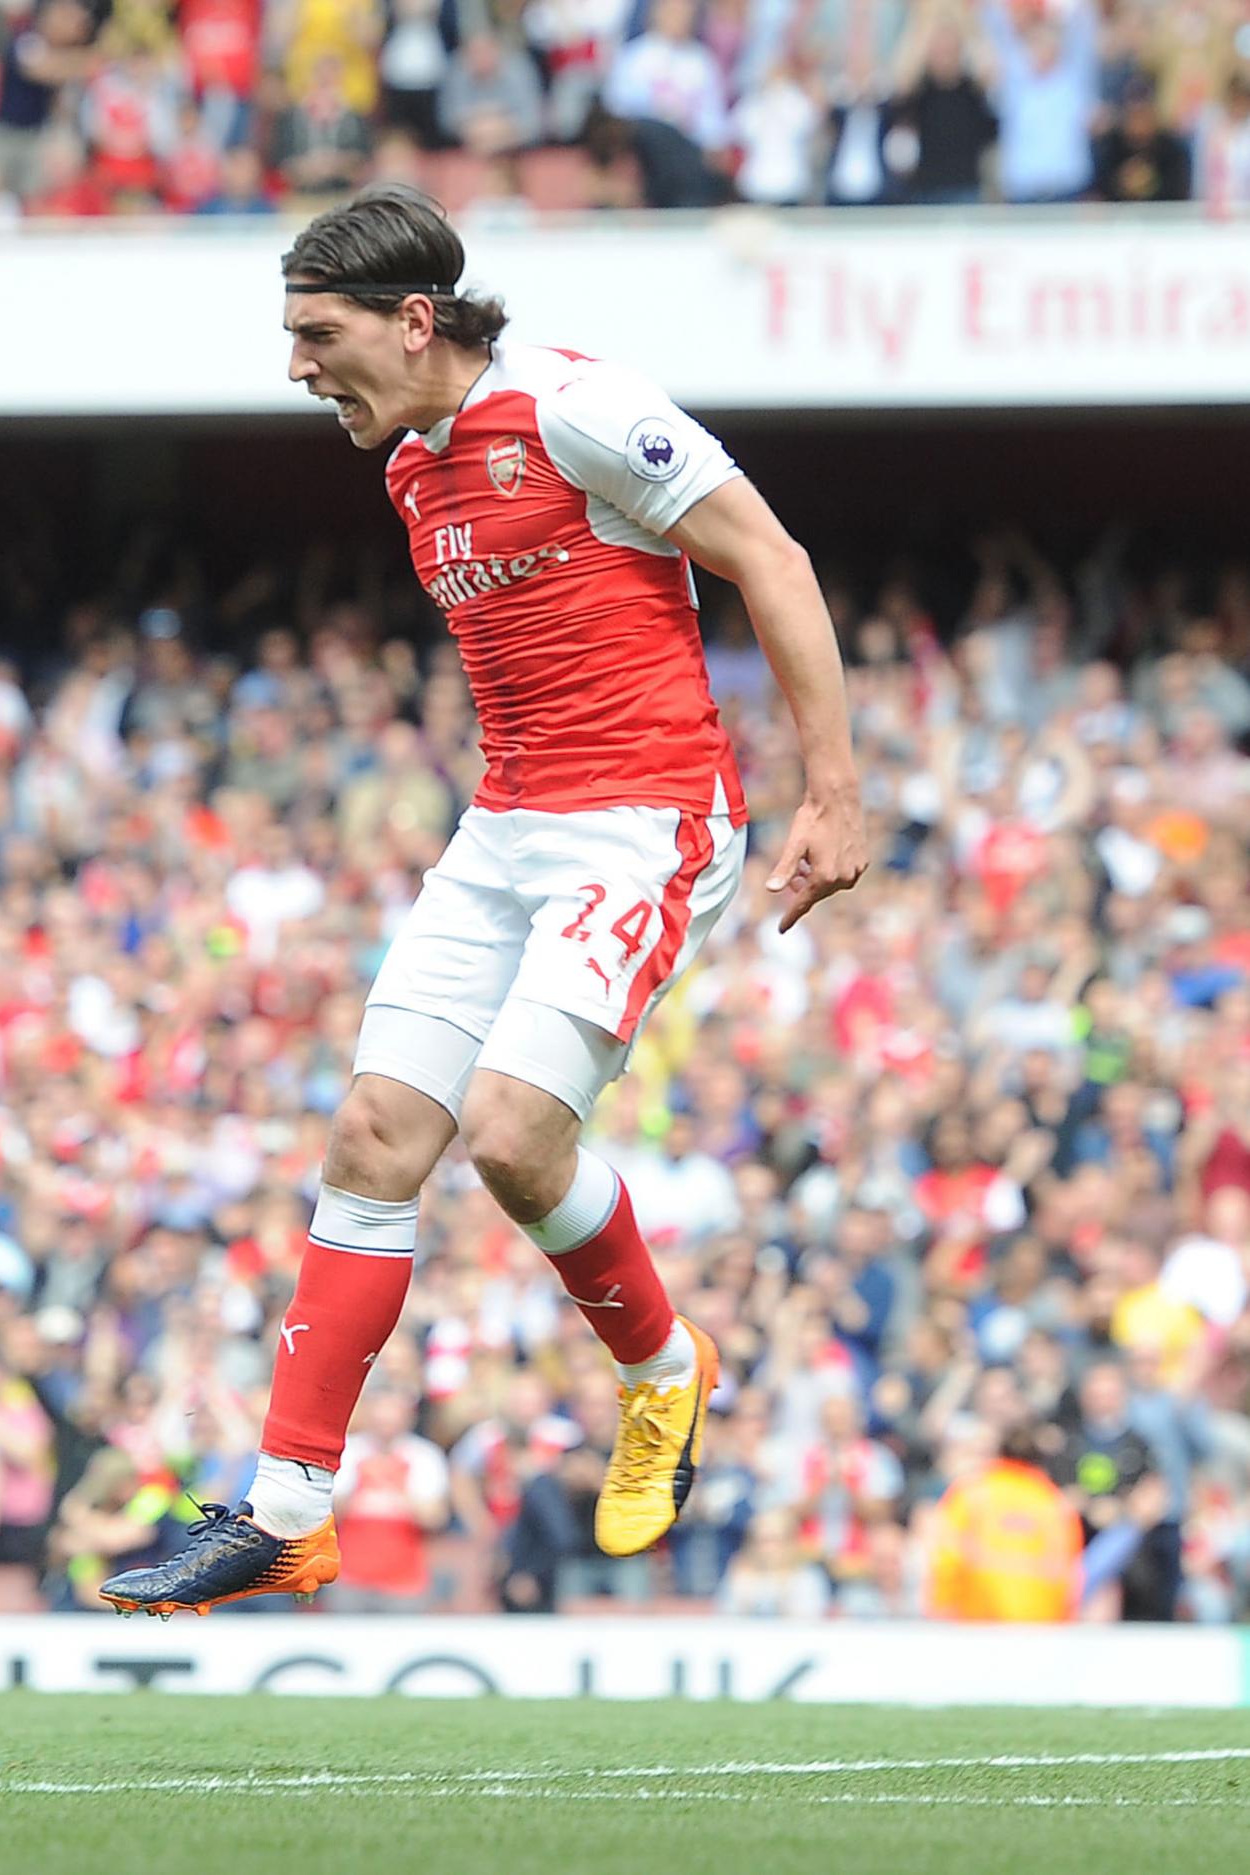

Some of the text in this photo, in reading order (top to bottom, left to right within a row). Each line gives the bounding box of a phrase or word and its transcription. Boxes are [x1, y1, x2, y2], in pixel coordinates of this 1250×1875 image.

[764, 261, 918, 365] Fly
[434, 522, 472, 565] Fly
[560, 883, 653, 968] 24
